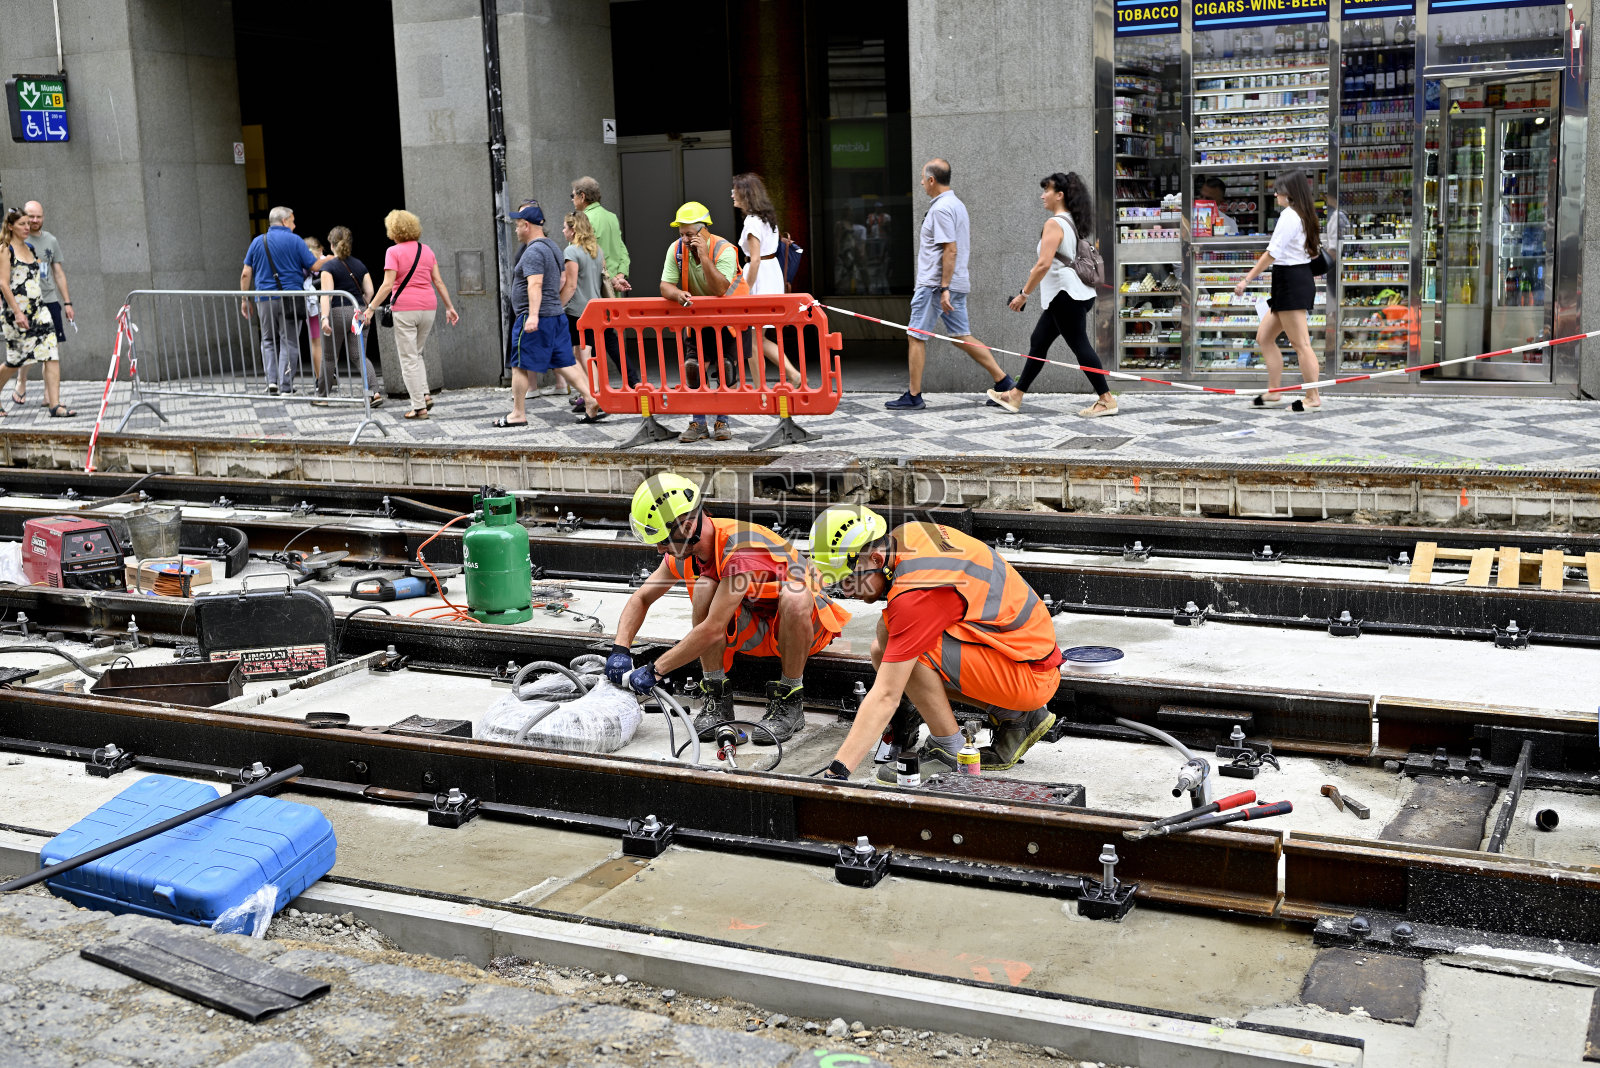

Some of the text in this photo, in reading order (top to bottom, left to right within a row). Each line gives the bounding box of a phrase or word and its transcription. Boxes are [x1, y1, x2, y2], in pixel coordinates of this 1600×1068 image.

[1117, 6, 1178, 21] TOBACCO
[45, 96, 60, 105] A B
[242, 651, 287, 662] LINCOLN
